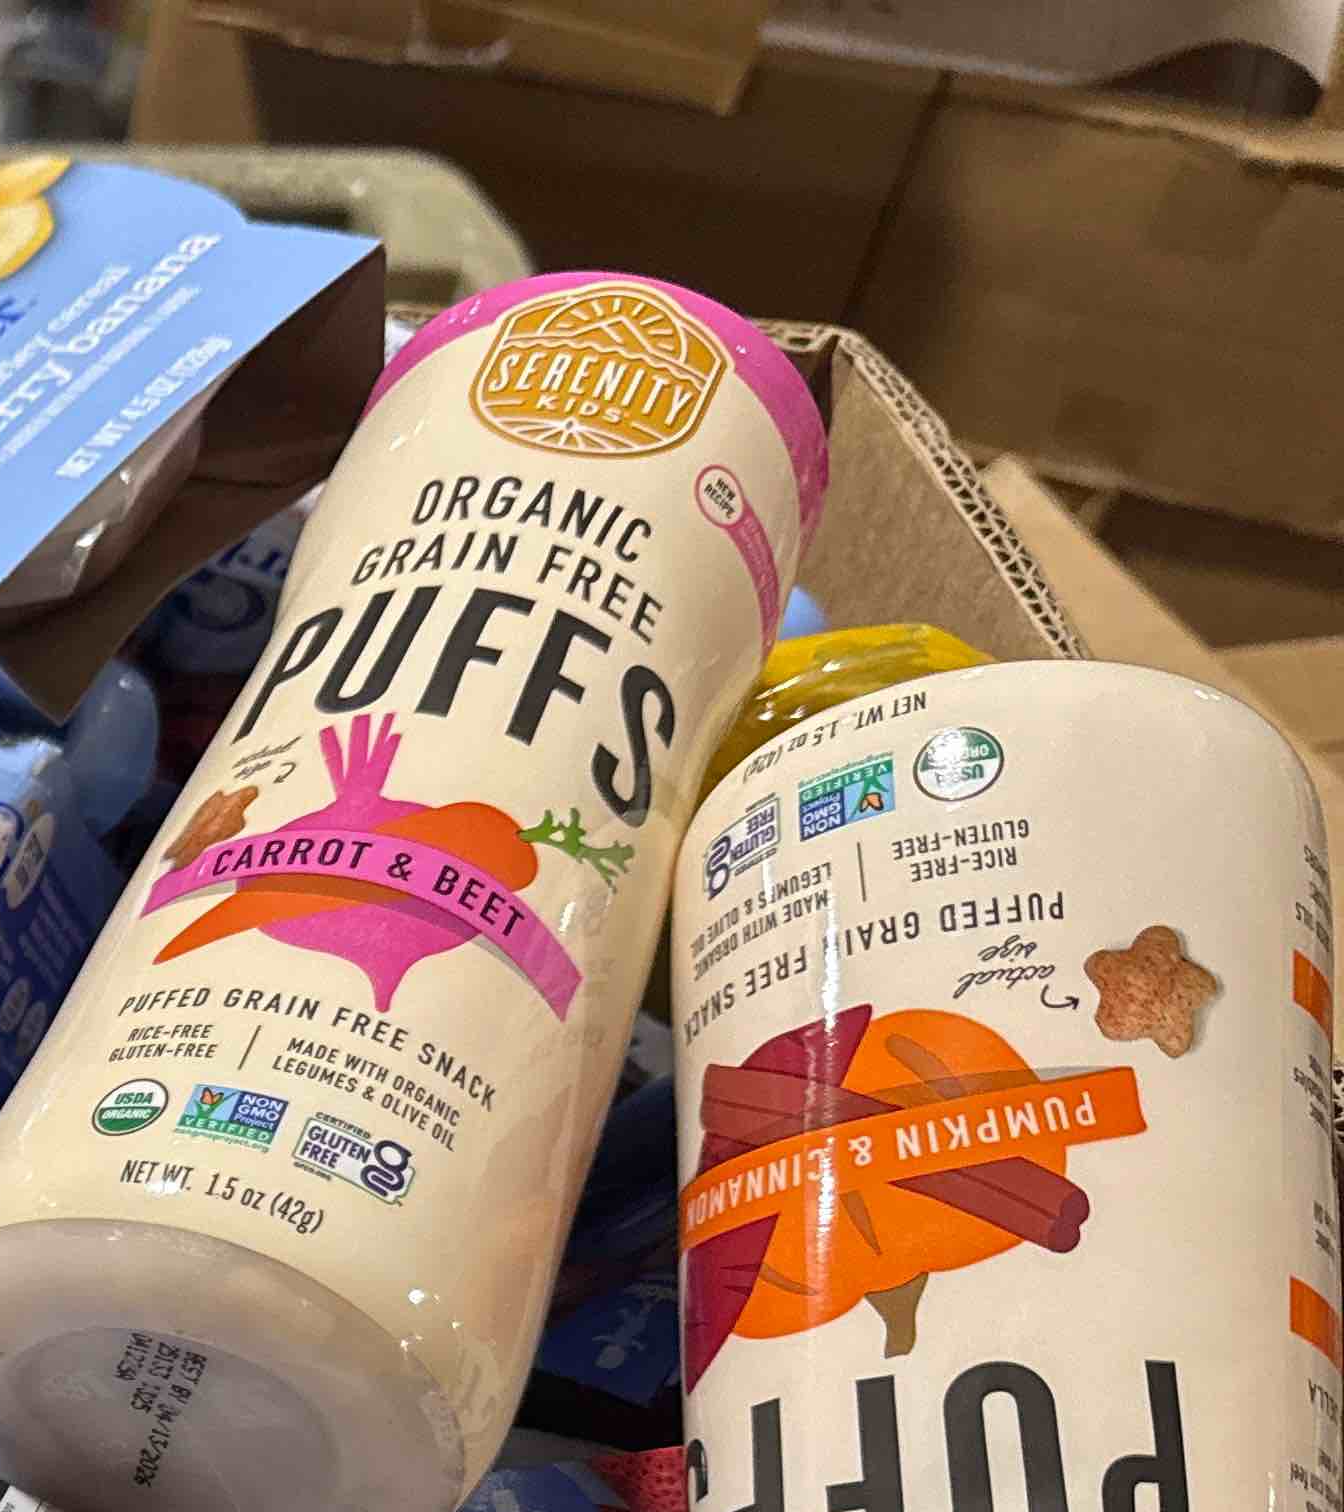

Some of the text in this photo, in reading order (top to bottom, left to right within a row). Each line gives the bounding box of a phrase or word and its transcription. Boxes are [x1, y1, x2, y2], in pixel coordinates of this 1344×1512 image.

[52, 233, 223, 355] banana
[488, 352, 694, 428] SERENITY
[537, 395, 621, 424] KIDS
[704, 483, 735, 518] RECIPE
[714, 476, 736, 501] NEW
[412, 476, 656, 564] ORGANIC
[350, 532, 664, 646] GRAIN FREE
[231, 585, 677, 828] PUFFS
[812, 691, 928, 747] NET 1.5
[800, 761, 891, 802] VERIFIED
[745, 805, 776, 835] FREE
[801, 802, 842, 826] GMO
[892, 819, 1030, 861] GLUTEN-FREE
[910, 846, 1017, 882] RICE-FREE
[212, 838, 528, 938] CARROT & BEET
[742, 889, 829, 943] MADE WITH
[744, 891, 1065, 998] PUFFED FREE
[978, 934, 1038, 962] size
[953, 964, 1057, 999] actual
[119, 988, 497, 1112] PUFFED GRAIN FREE SNACK
[128, 1024, 213, 1042] RICE-FREE
[109, 1043, 219, 1063] GLUTEN-FREE
[113, 1092, 154, 1106] USDA
[287, 1038, 462, 1127] MADE WITH ORGANIC
[101, 1107, 152, 1121] ORGANIC
[238, 1104, 281, 1121] GMO
[241, 1094, 283, 1111] NON
[272, 1055, 456, 1152] LEGUMES OLIVE OIL
[183, 1115, 270, 1142] VERIFIED
[307, 1125, 372, 1164] GLUTEN
[847, 1090, 1098, 1166] PUMPKIN &
[299, 1141, 340, 1169] FREE
[121, 1160, 326, 1234] NET 1.5 oz (42g)
